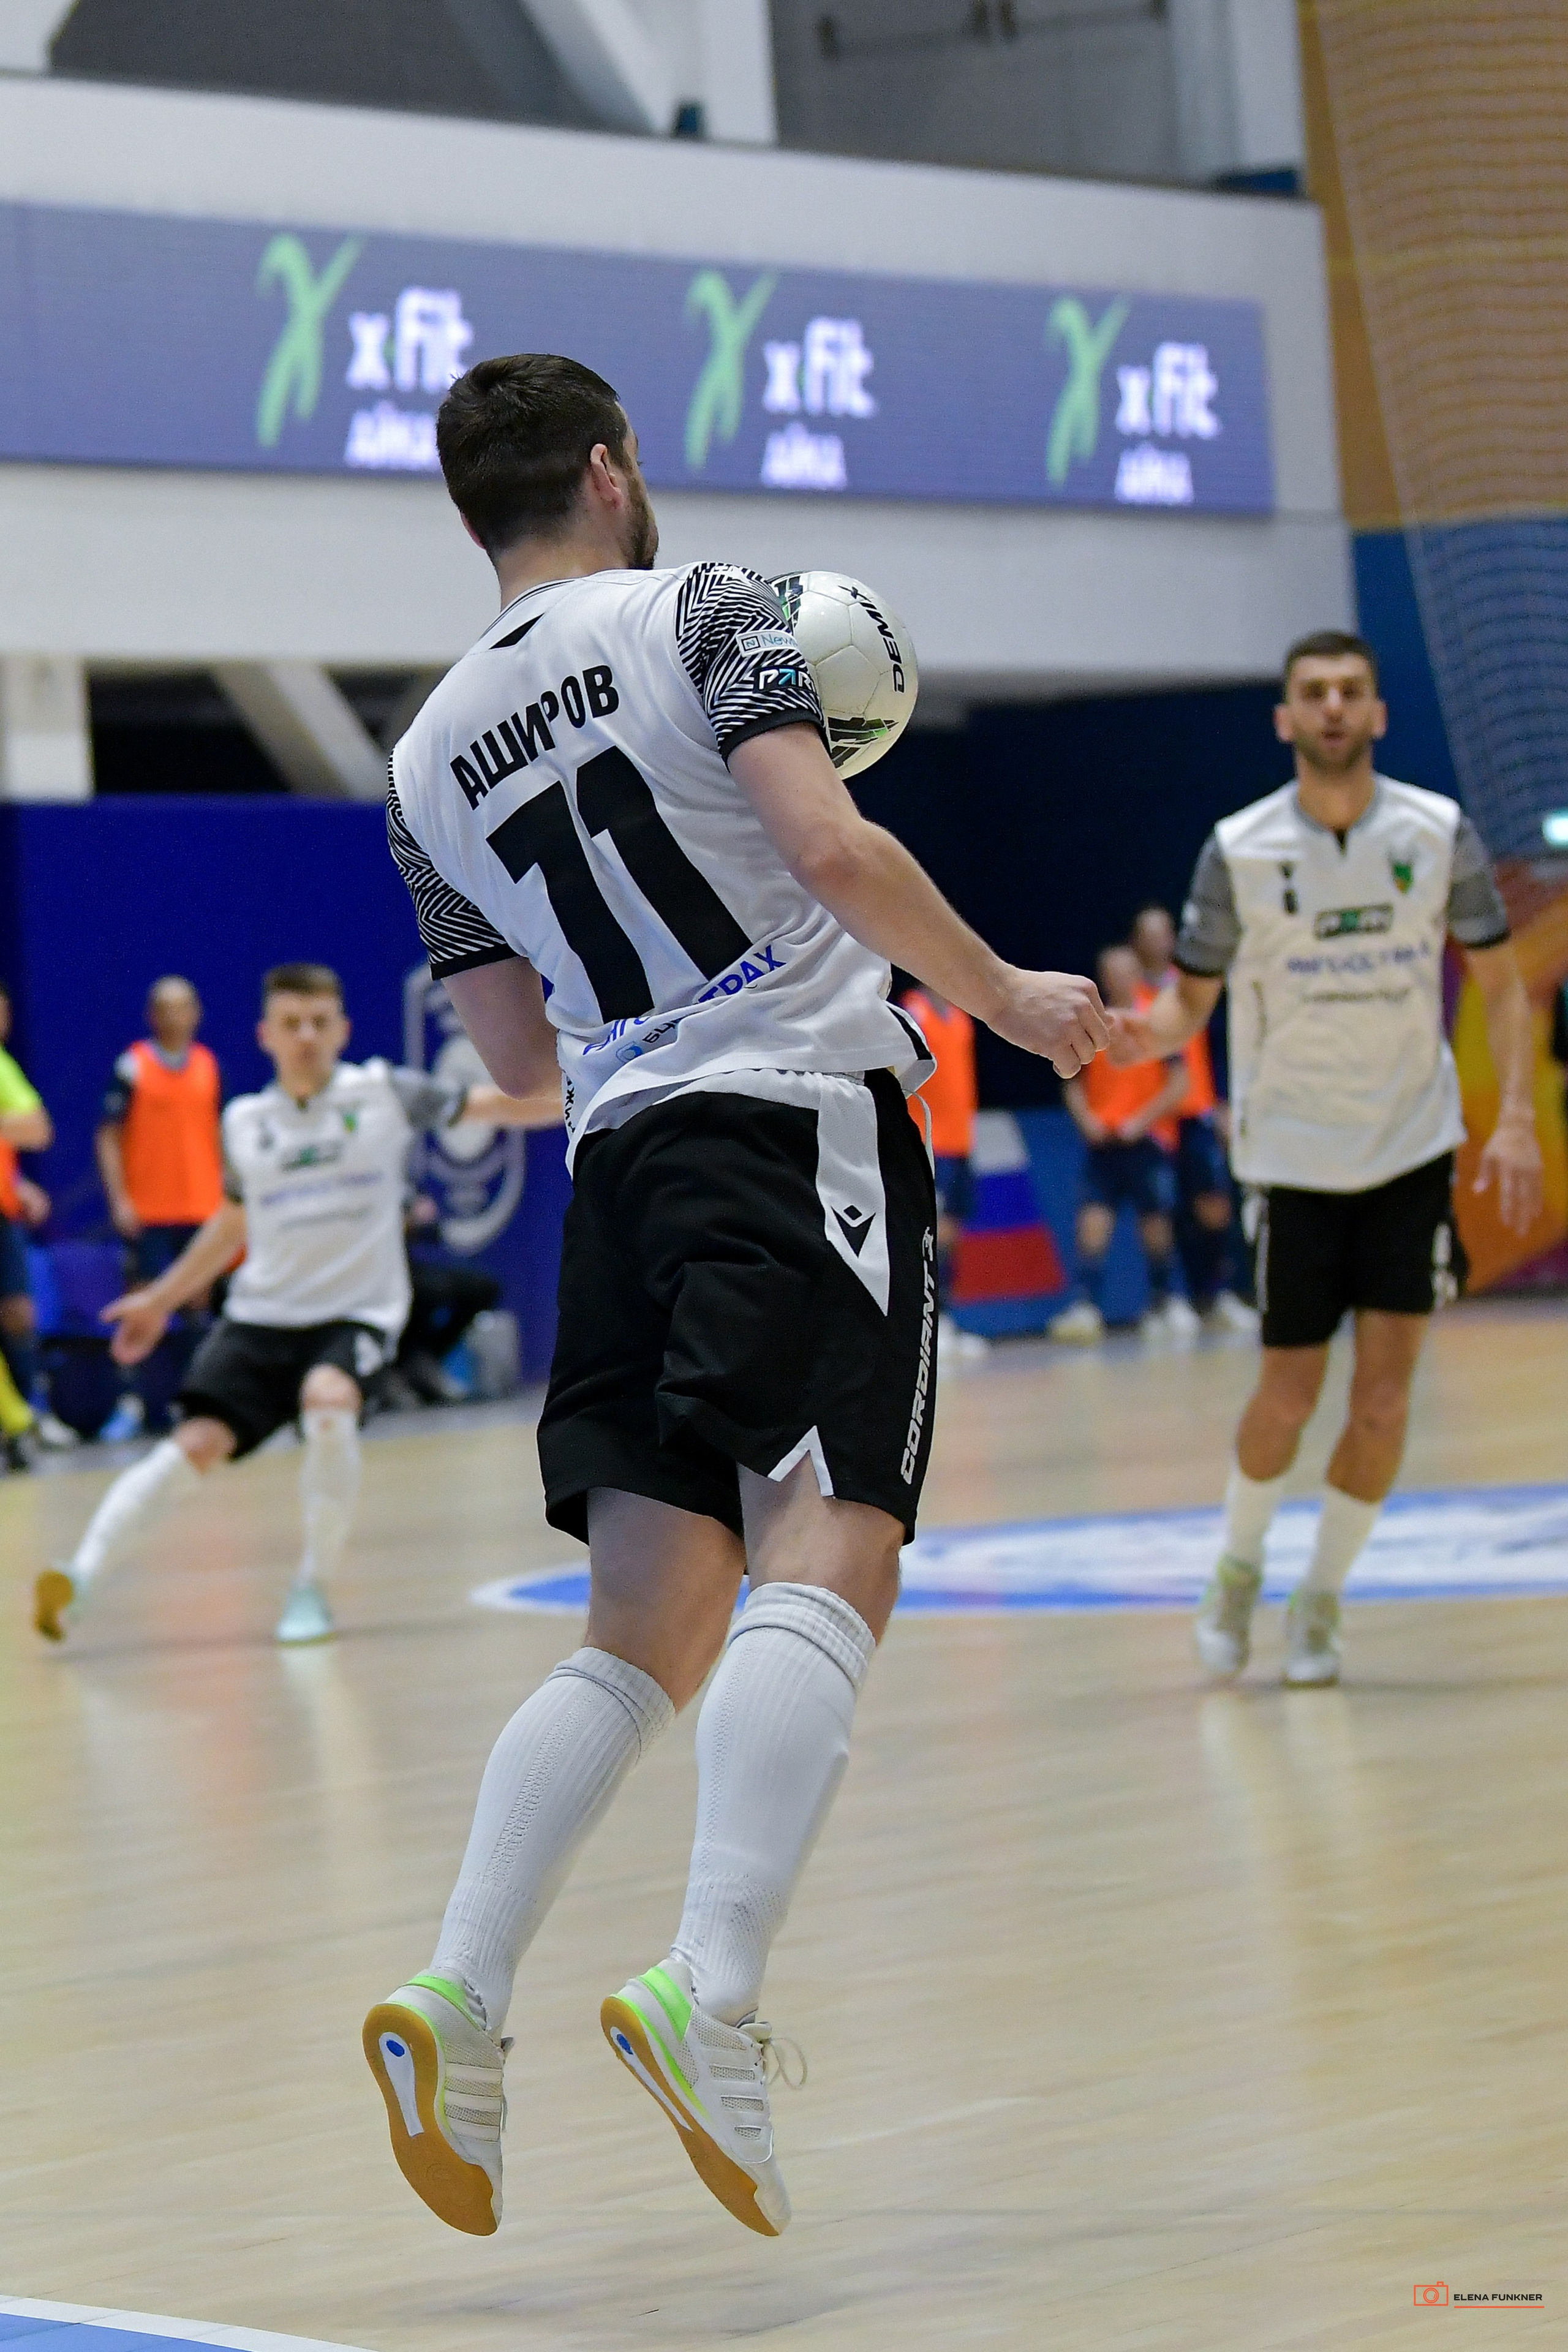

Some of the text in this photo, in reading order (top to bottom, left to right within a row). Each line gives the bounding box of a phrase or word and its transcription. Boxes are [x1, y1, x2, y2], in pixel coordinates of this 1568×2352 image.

[837, 585, 905, 693] DEMIX
[450, 665, 619, 811] АШИРОВ
[901, 1260, 935, 1484] CORDIANT
